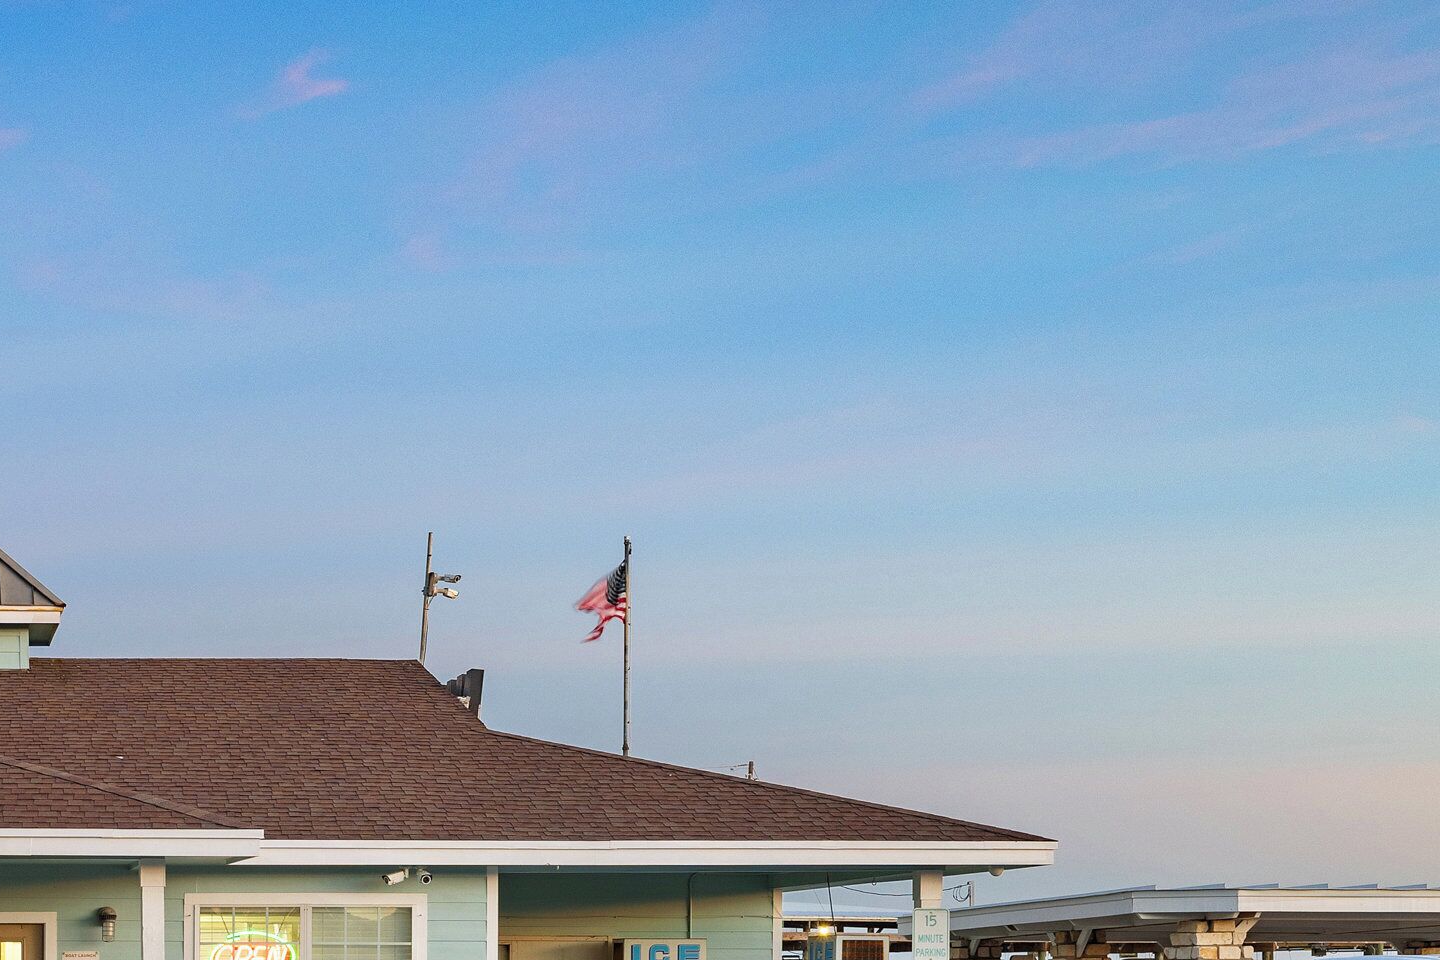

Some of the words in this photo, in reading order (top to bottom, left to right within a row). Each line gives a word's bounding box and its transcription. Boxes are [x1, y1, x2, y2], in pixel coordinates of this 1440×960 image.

[925, 915, 937, 927] 15
[918, 934, 944, 944] MINUTE
[915, 948, 946, 957] PARKING
